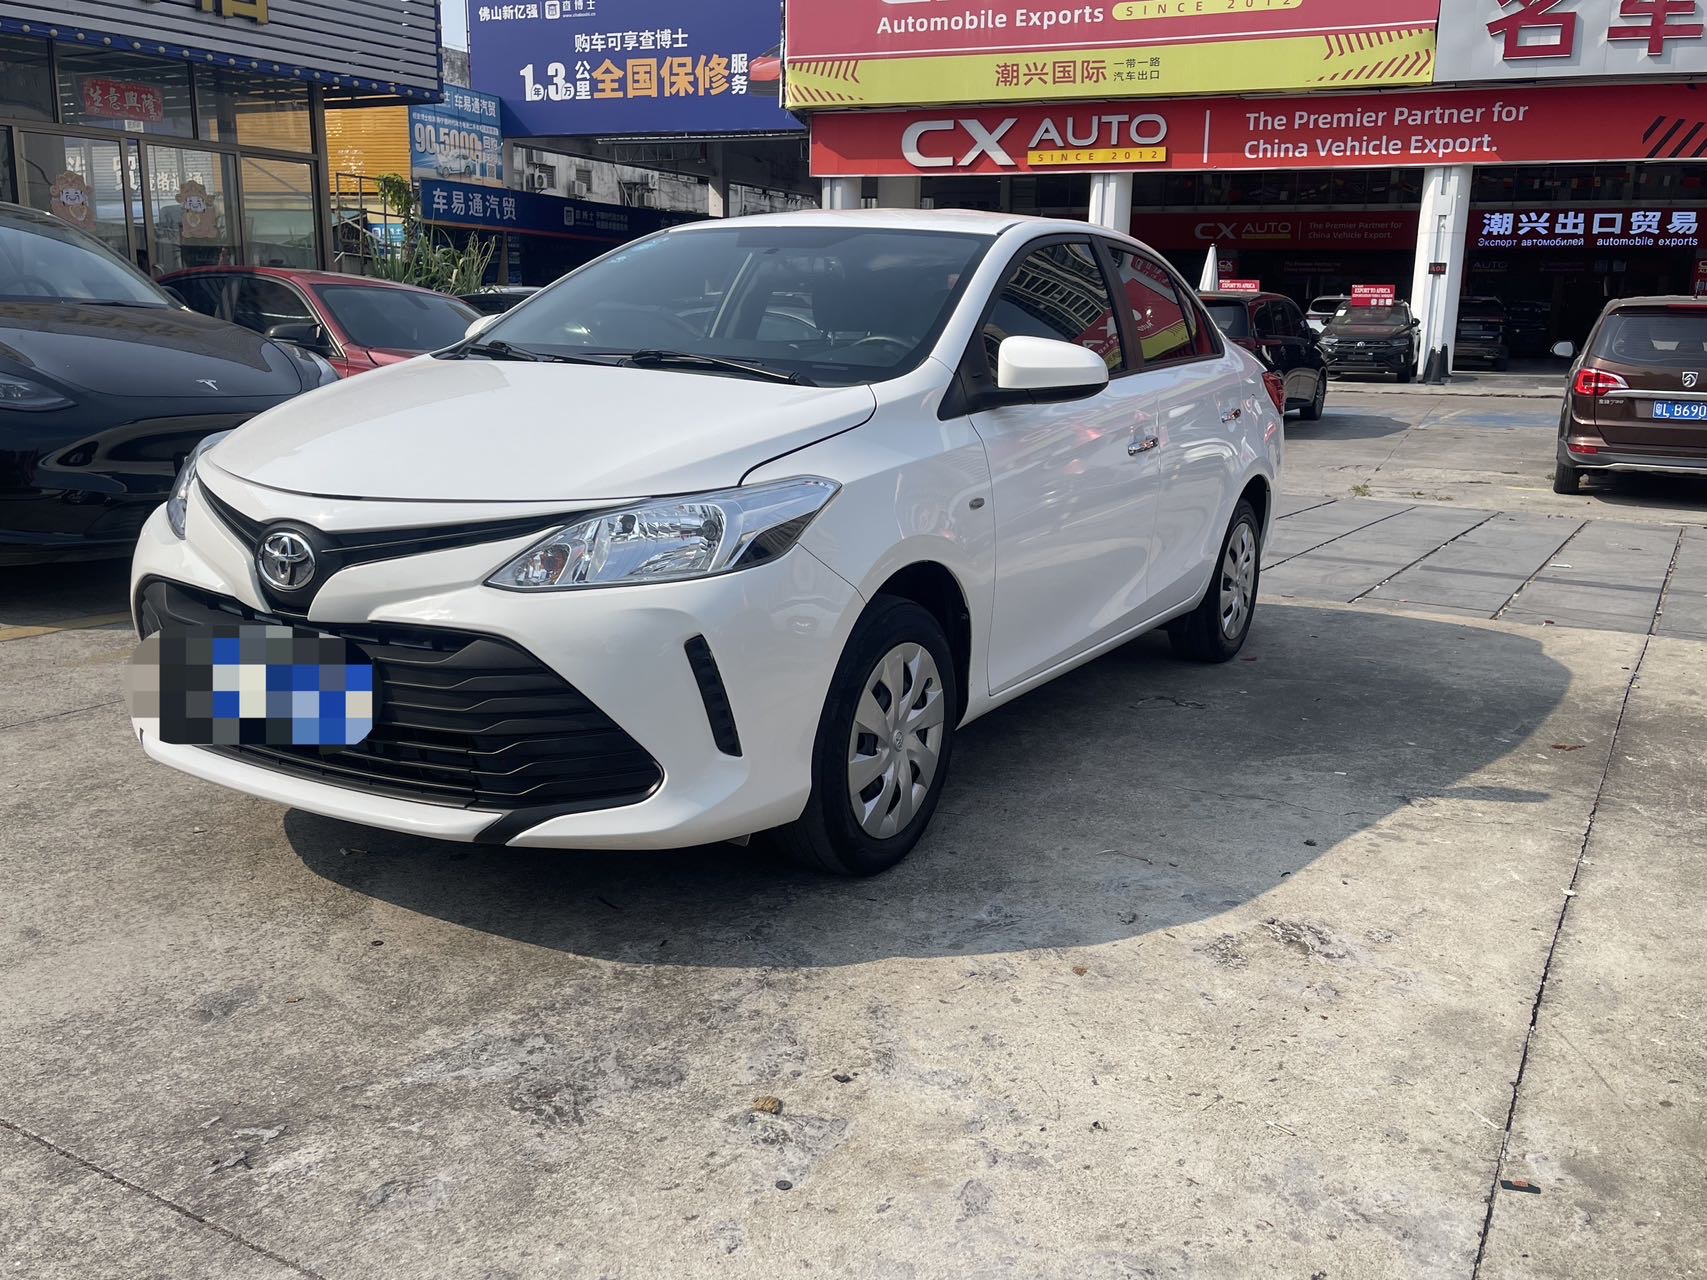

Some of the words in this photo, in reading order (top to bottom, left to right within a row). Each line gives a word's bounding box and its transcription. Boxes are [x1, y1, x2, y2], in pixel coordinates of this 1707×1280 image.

[479, 4, 539, 21] 佛山新亿强
[877, 10, 1007, 34] Automobile
[1016, 6, 1104, 30] Exports
[1126, 1, 1203, 16] SINCE
[574, 28, 688, 53] 购车可享查博士
[995, 60, 1107, 87] 潮兴国际
[1113, 57, 1160, 68] 一带一路
[1113, 70, 1160, 82] 汽车出口
[454, 94, 496, 118] 车易通汽贸
[1246, 112, 1287, 131] The
[1294, 108, 1387, 129] Premier
[1394, 106, 1486, 126] Partner
[1493, 102, 1528, 123] for
[901, 118, 1018, 167] CX
[1028, 113, 1168, 148] AUTO
[1245, 139, 1308, 159] China
[1316, 135, 1402, 157] Vehicle
[1410, 133, 1498, 158] Export.
[1038, 152, 1094, 162] SINCE
[1111, 150, 1158, 160] 2012
[432, 188, 517, 221] 车易通汽贸
[1242, 222, 1292, 233] AUTO
[1481, 211, 1698, 236] 潮兴出口贸易
[1478, 238, 1517, 247] Экспорт
[1521, 237, 1584, 247] автомобилей
[1596, 237, 1654, 246] automobile
[1658, 238, 1698, 247] exports
